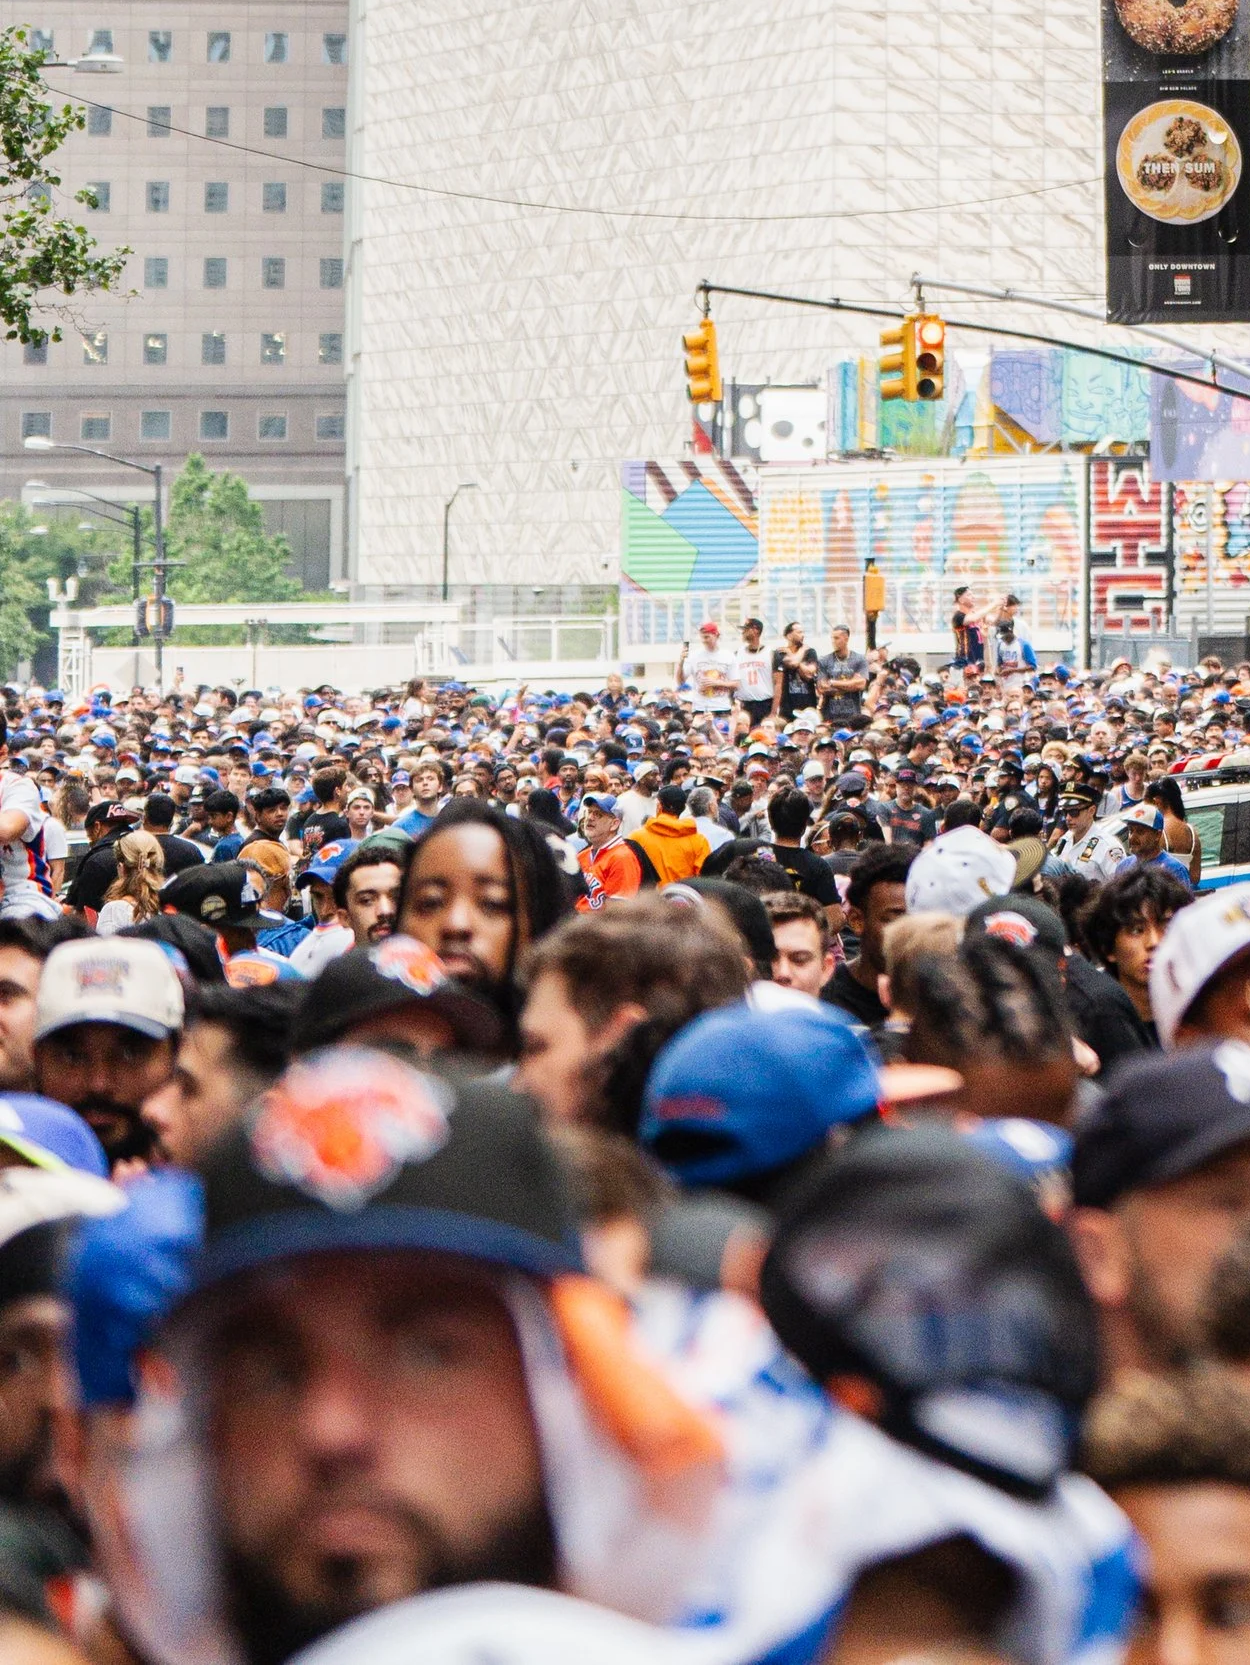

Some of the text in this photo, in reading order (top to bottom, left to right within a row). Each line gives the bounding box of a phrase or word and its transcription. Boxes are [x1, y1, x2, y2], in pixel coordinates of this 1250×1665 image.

[1144, 162, 1216, 175] THEN SUM
[1148, 262, 1216, 271] ONLY DOWNTOWN
